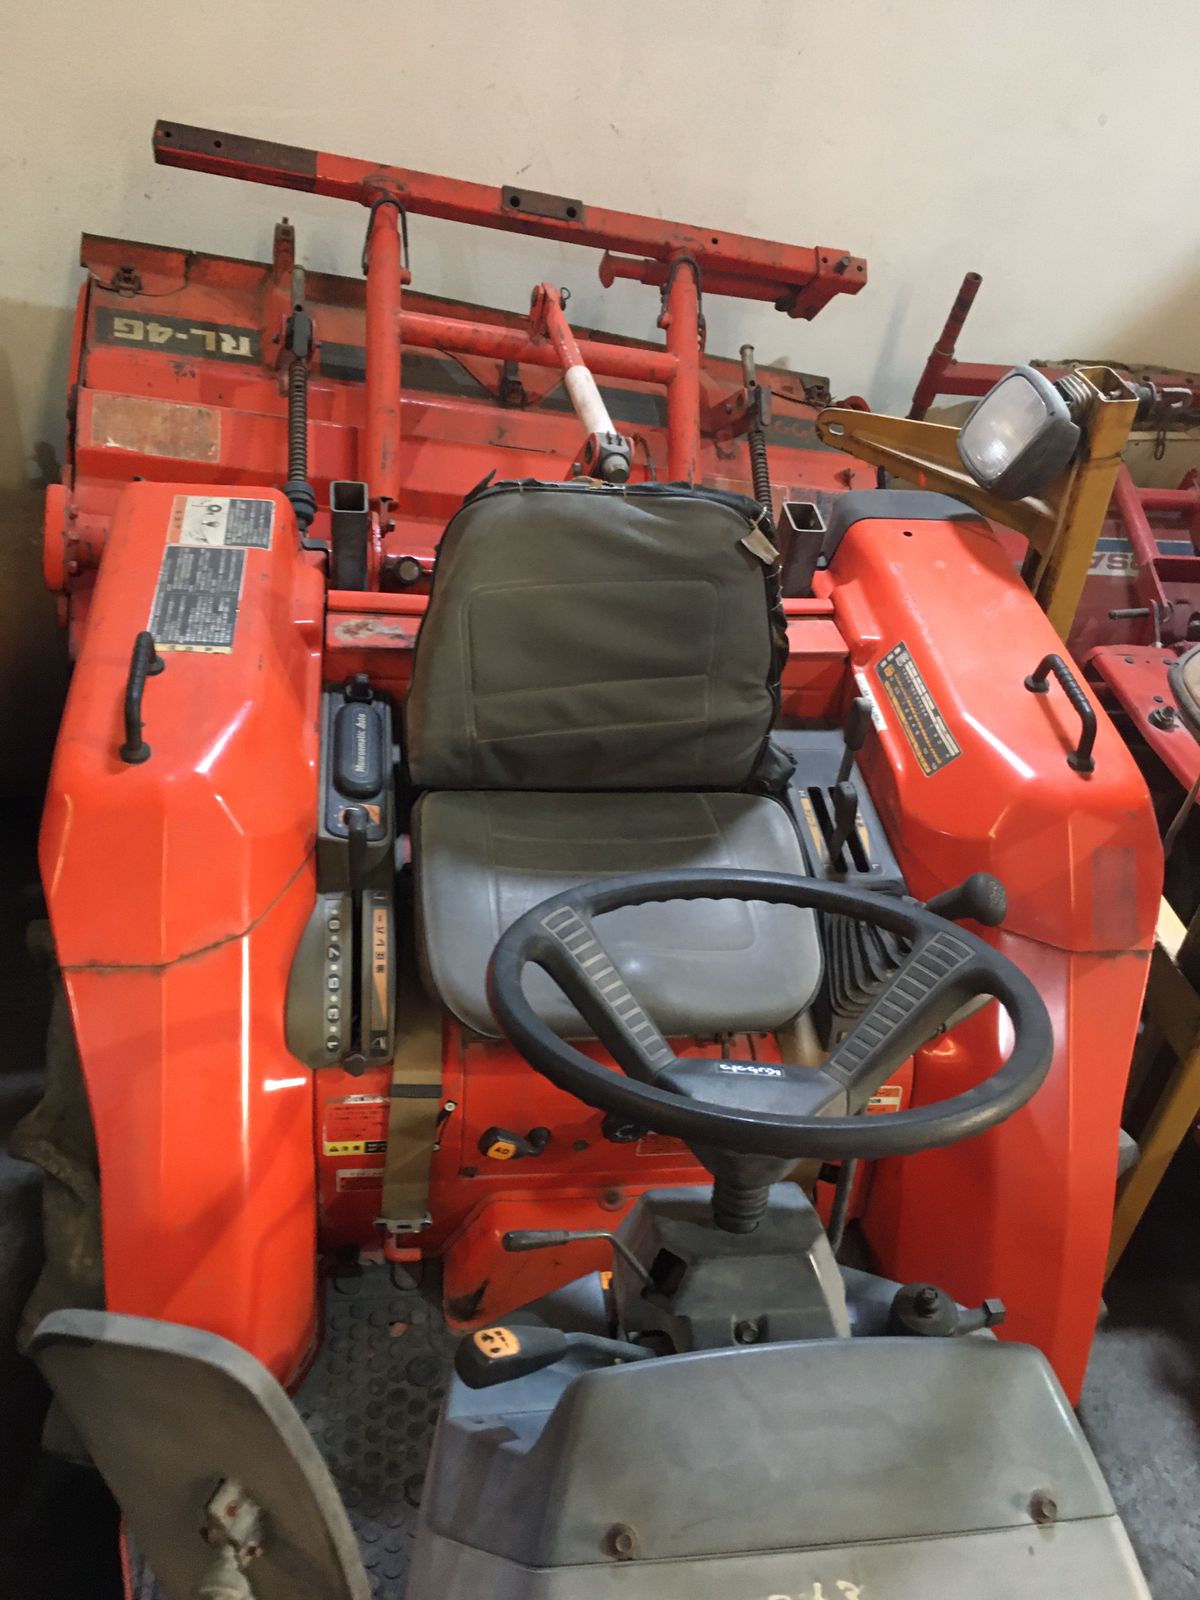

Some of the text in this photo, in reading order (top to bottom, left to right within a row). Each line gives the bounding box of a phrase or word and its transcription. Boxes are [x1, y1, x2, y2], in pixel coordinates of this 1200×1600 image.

[113, 316, 254, 358] RL-4G
[328, 947, 339, 958] 7
[327, 1008, 339, 1019] 3
[719, 1064, 781, 1075] Kubota
